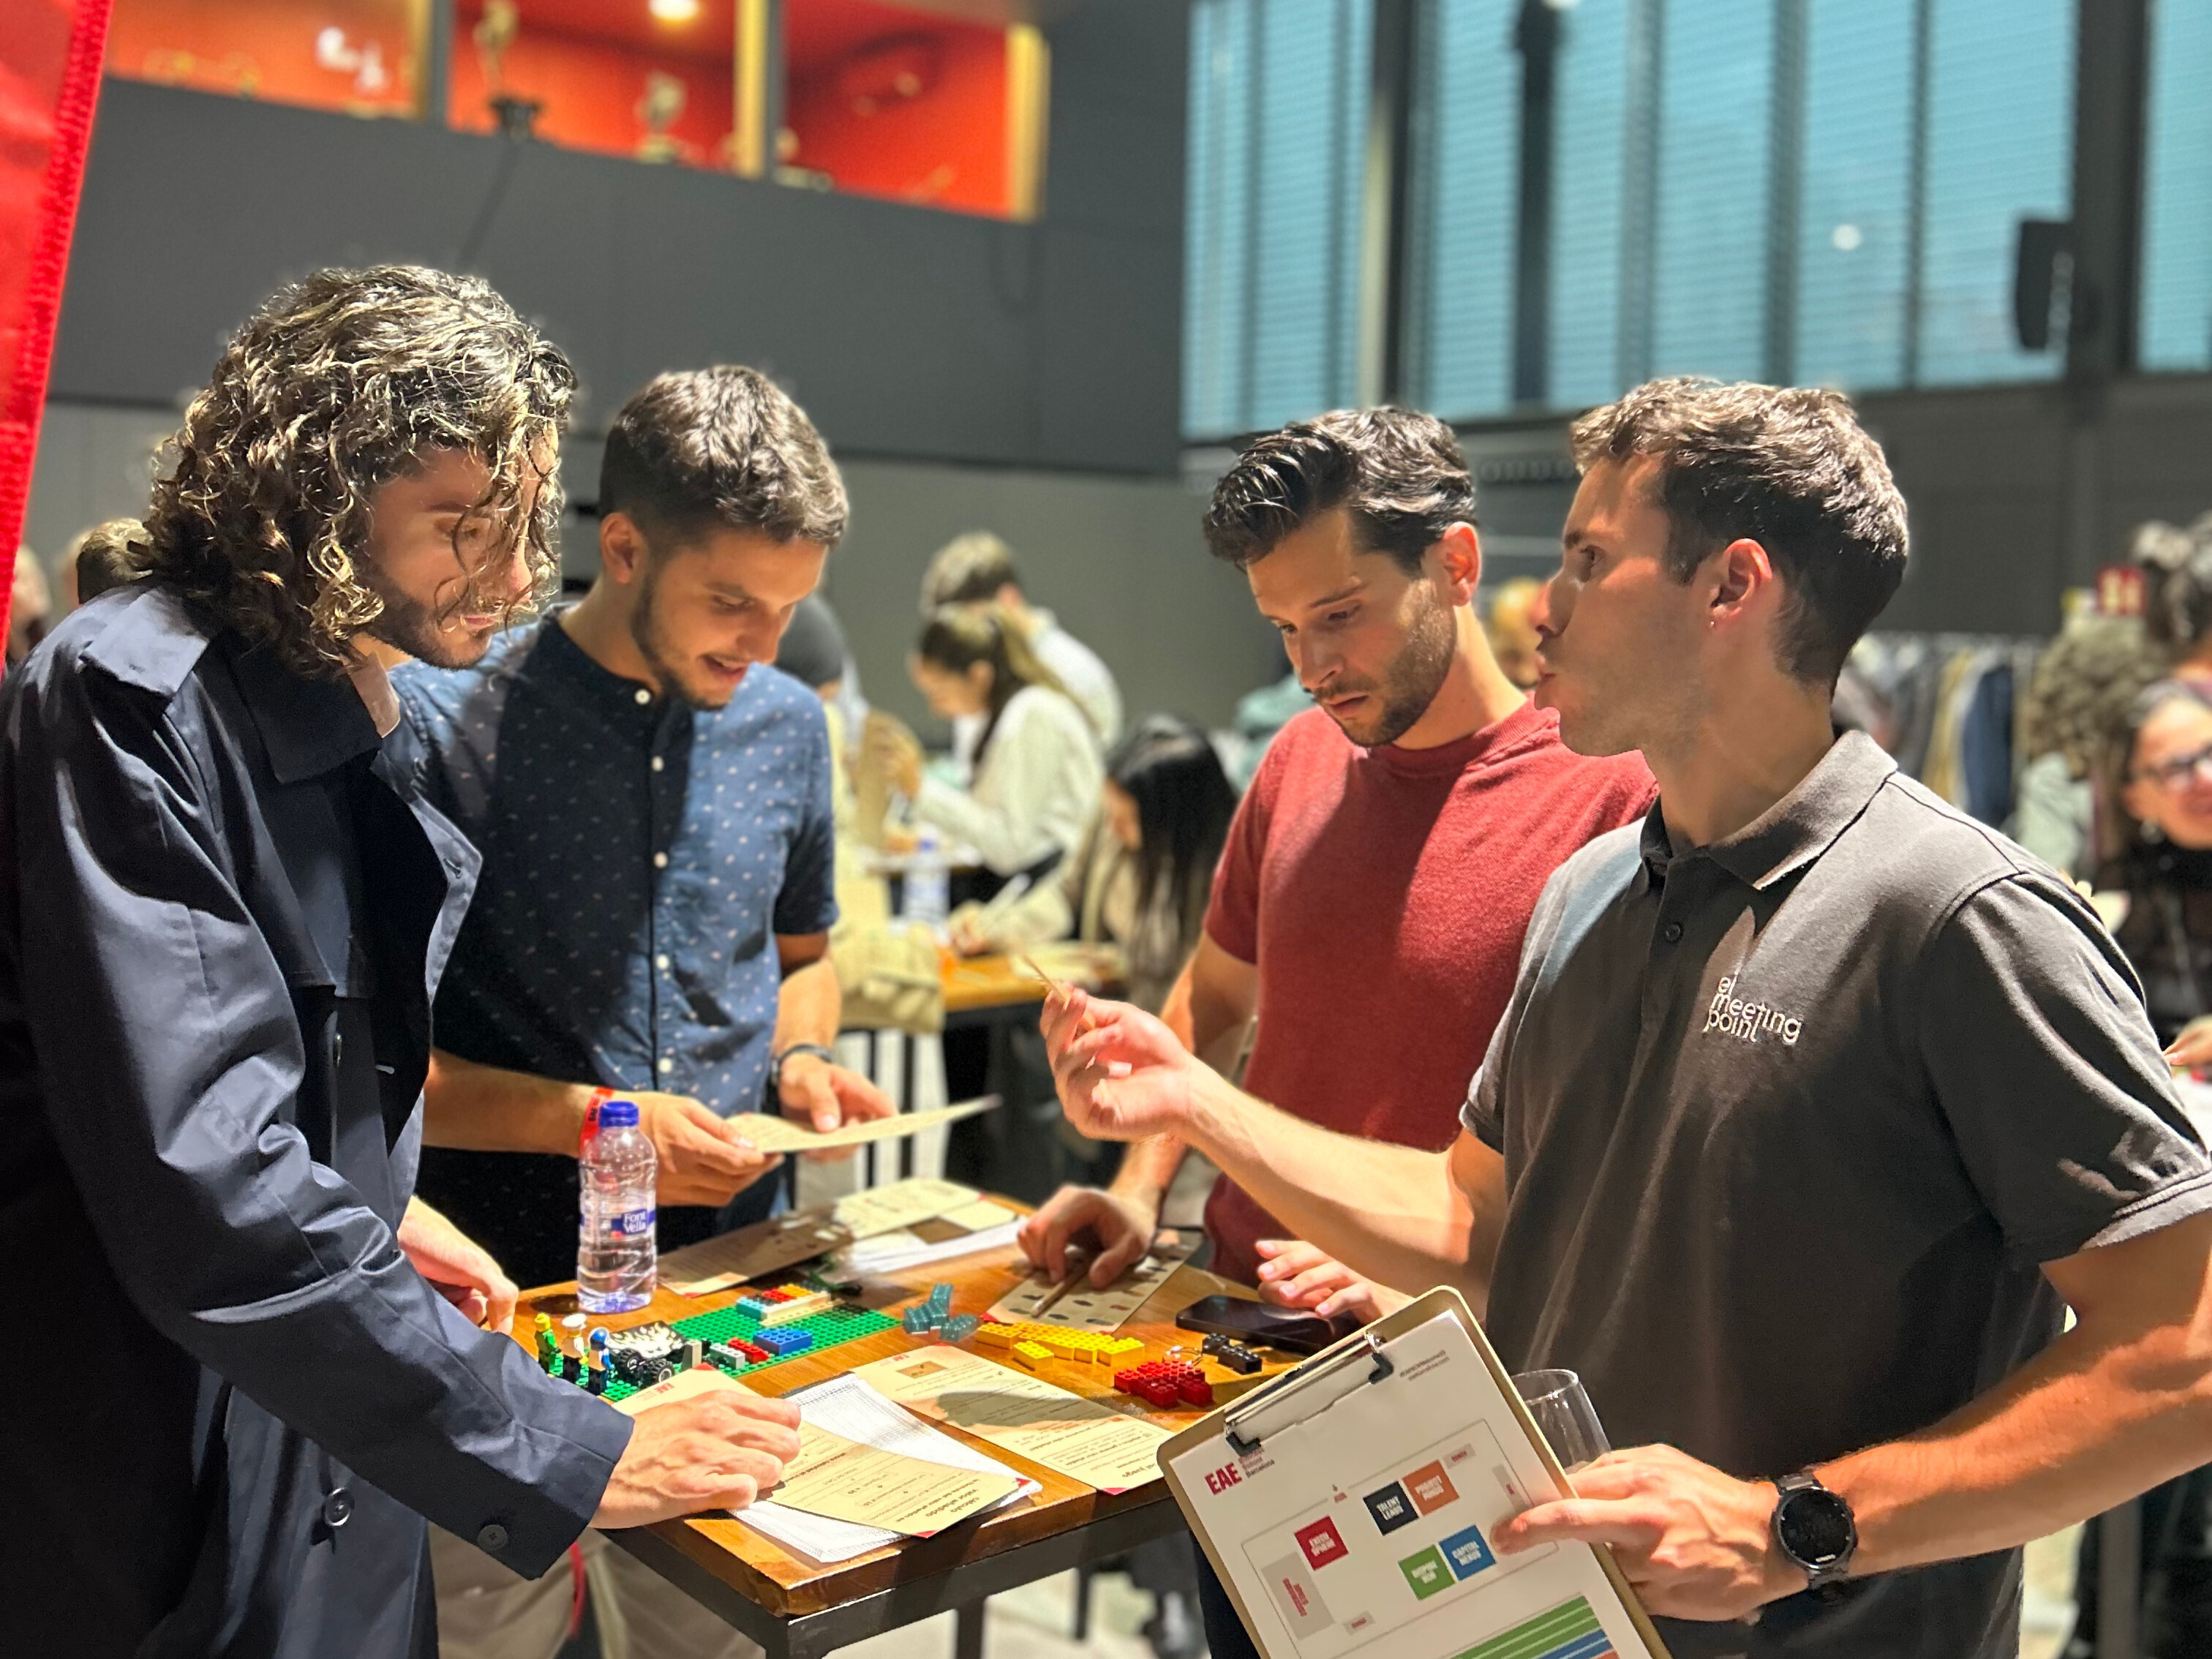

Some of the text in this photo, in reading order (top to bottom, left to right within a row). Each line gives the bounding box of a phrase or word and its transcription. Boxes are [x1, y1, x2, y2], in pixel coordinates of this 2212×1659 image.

[1718, 972, 1739, 995] el
[1703, 1009, 1762, 1042] point
[1711, 993, 1802, 1044] meeting
[623, 1222, 646, 1233] Vella
[624, 1211, 646, 1222] Font
[1205, 1462, 1242, 1494] EAE
[926, 1489, 977, 1516] valor añadido
